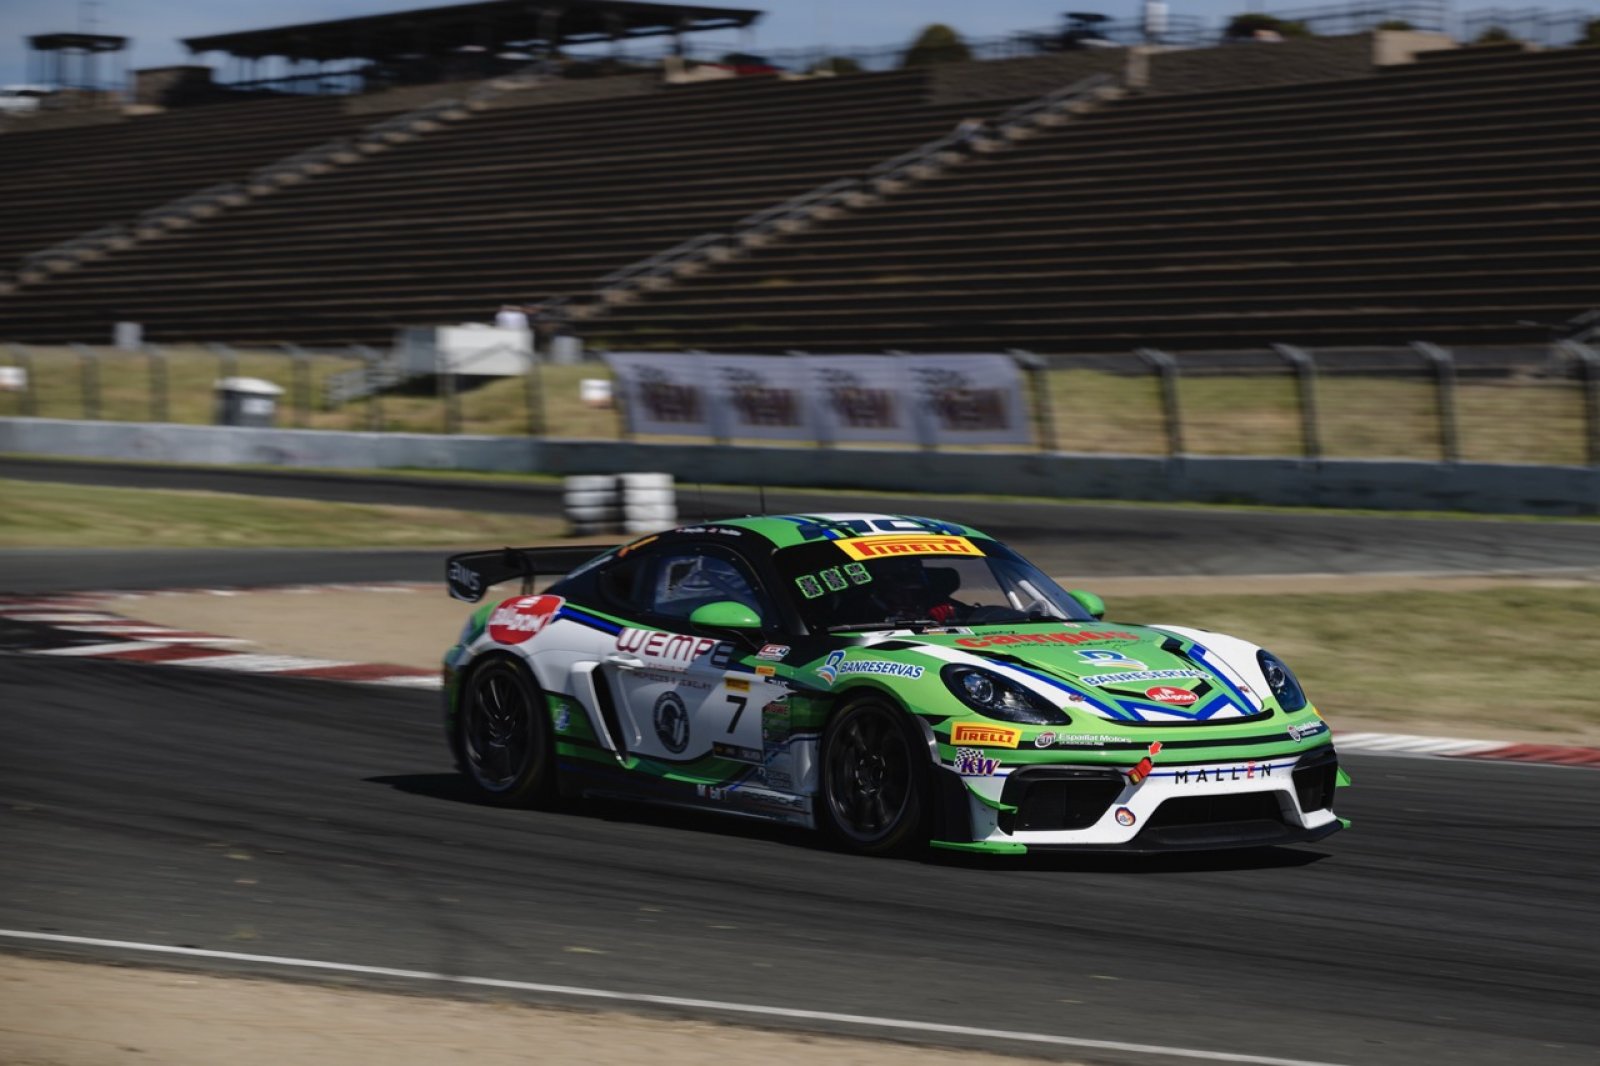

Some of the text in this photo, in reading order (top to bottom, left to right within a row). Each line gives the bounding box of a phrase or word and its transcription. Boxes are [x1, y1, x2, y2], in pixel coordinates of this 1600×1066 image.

[851, 538, 971, 557] PIRELLI
[616, 626, 738, 670] WEMPE
[840, 660, 924, 679] BANRESERVAS
[1082, 669, 1211, 686] BANRESERVAS
[726, 694, 748, 734] 7
[955, 725, 1015, 744] PIRELLI
[1099, 734, 1132, 744] Motors
[960, 757, 1000, 776] KW
